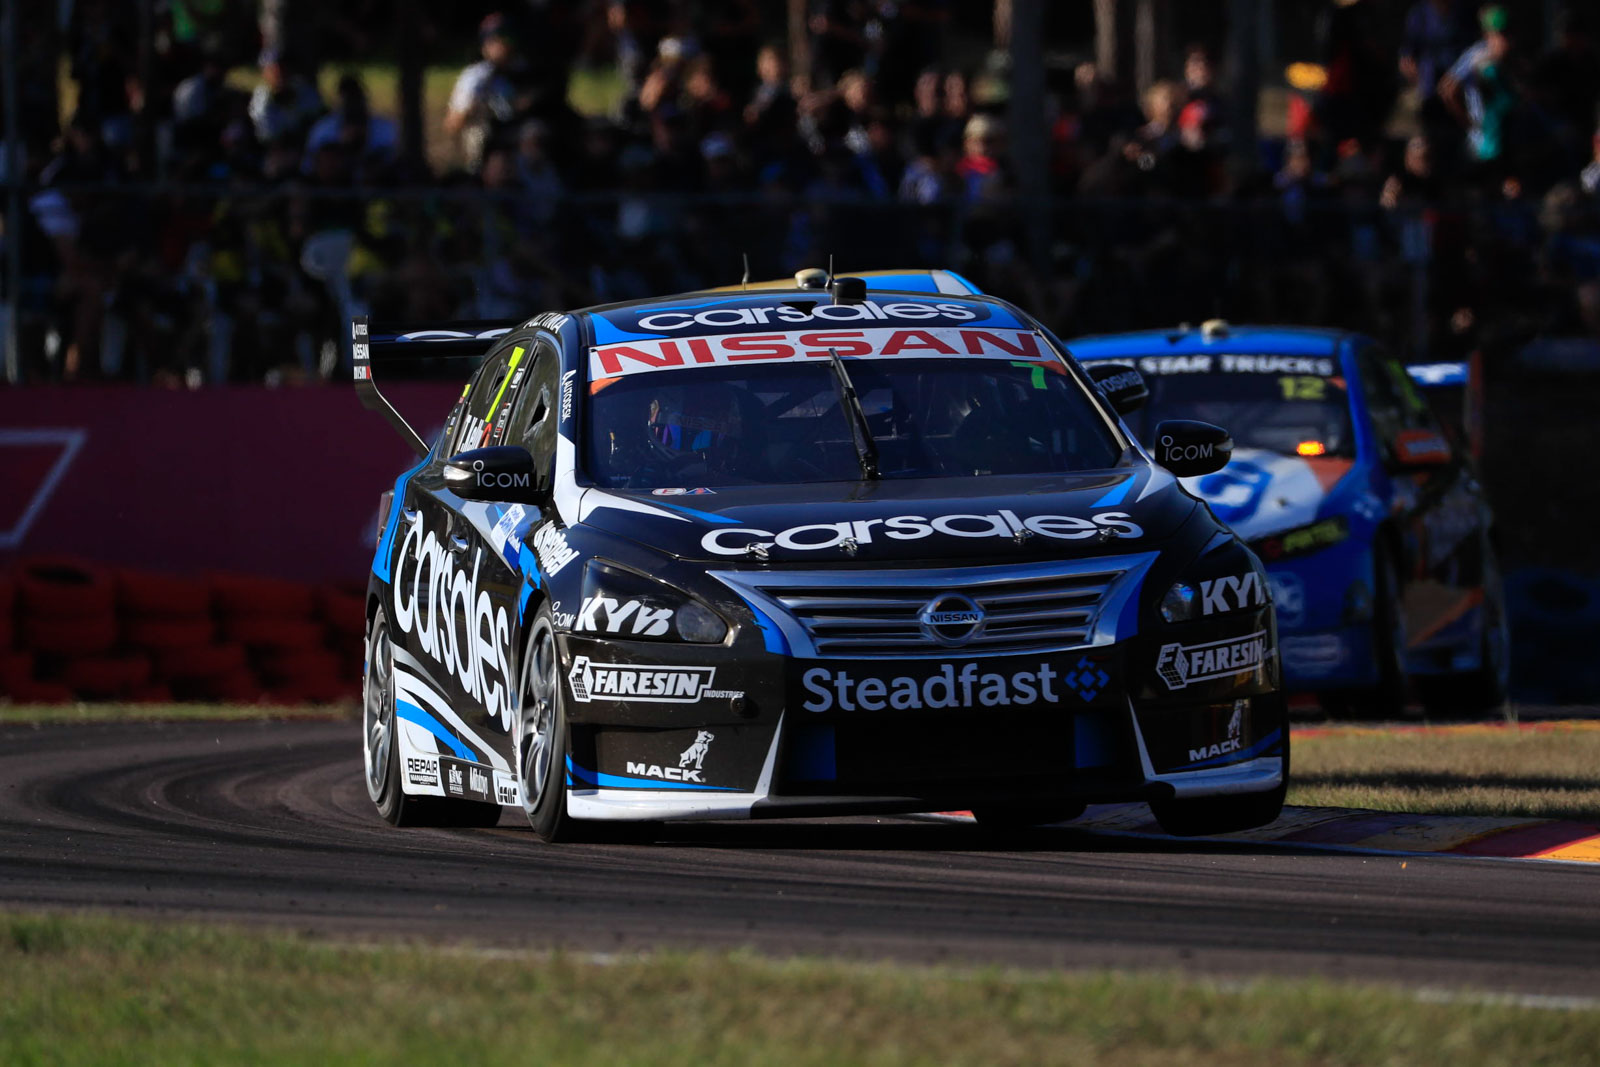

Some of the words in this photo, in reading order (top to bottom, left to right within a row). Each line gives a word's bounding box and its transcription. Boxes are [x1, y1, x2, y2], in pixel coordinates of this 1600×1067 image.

[637, 300, 977, 332] carsales
[352, 343, 370, 360] NISSAN
[595, 329, 1043, 375] NISSAN
[1138, 354, 1214, 376] STAR
[1219, 354, 1334, 376] TRUCKS
[1010, 360, 1048, 390] 7
[1277, 376, 1327, 400] 12
[700, 509, 1145, 556] carsales
[393, 510, 512, 733] carsales
[573, 597, 675, 637] KYB
[929, 611, 984, 624] NISSAN
[1190, 638, 1264, 676] FARESIN
[594, 669, 700, 696] FARESIN
[703, 689, 746, 699] INDUSTRIES
[802, 660, 1061, 713] Steadfast
[1188, 737, 1241, 762] MACK
[407, 757, 438, 773] REPAIR
[626, 761, 704, 783] MACK
